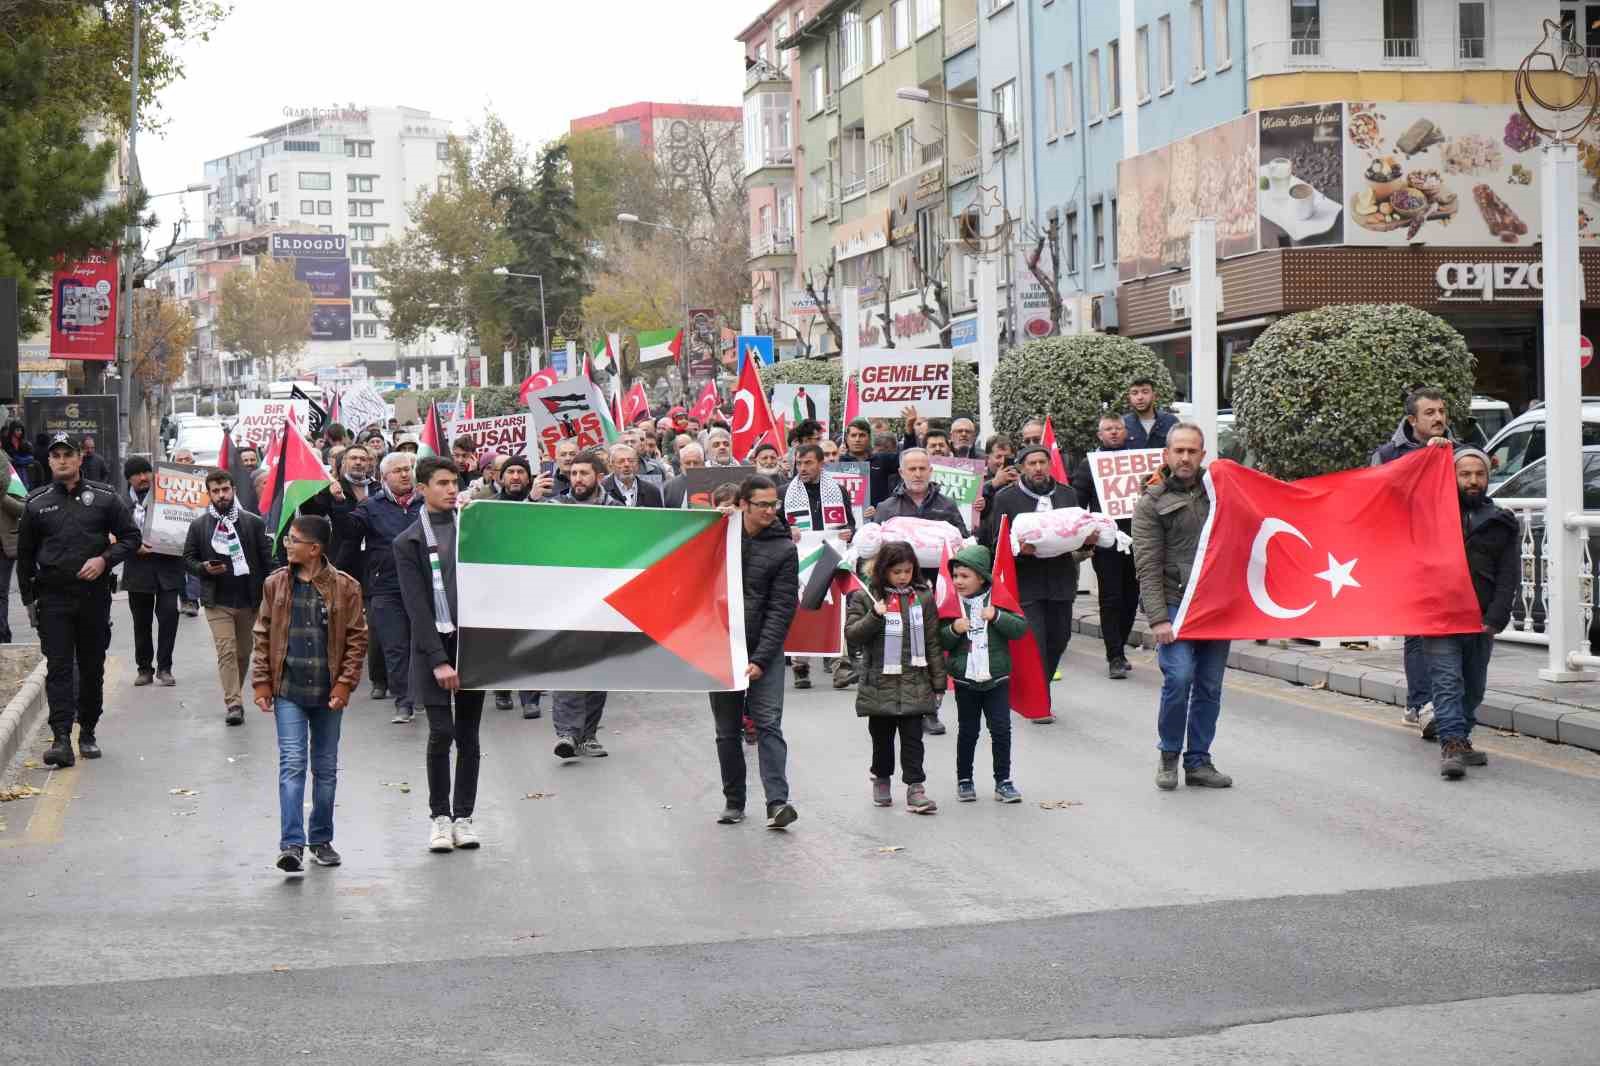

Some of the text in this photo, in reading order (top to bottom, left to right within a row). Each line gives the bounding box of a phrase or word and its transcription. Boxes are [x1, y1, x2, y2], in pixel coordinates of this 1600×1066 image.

[861, 384, 949, 403] GAZZE'YE
[456, 415, 526, 434] ZULME KARŞI
[472, 425, 527, 448] USAN
[1097, 452, 1161, 477] BEBE
